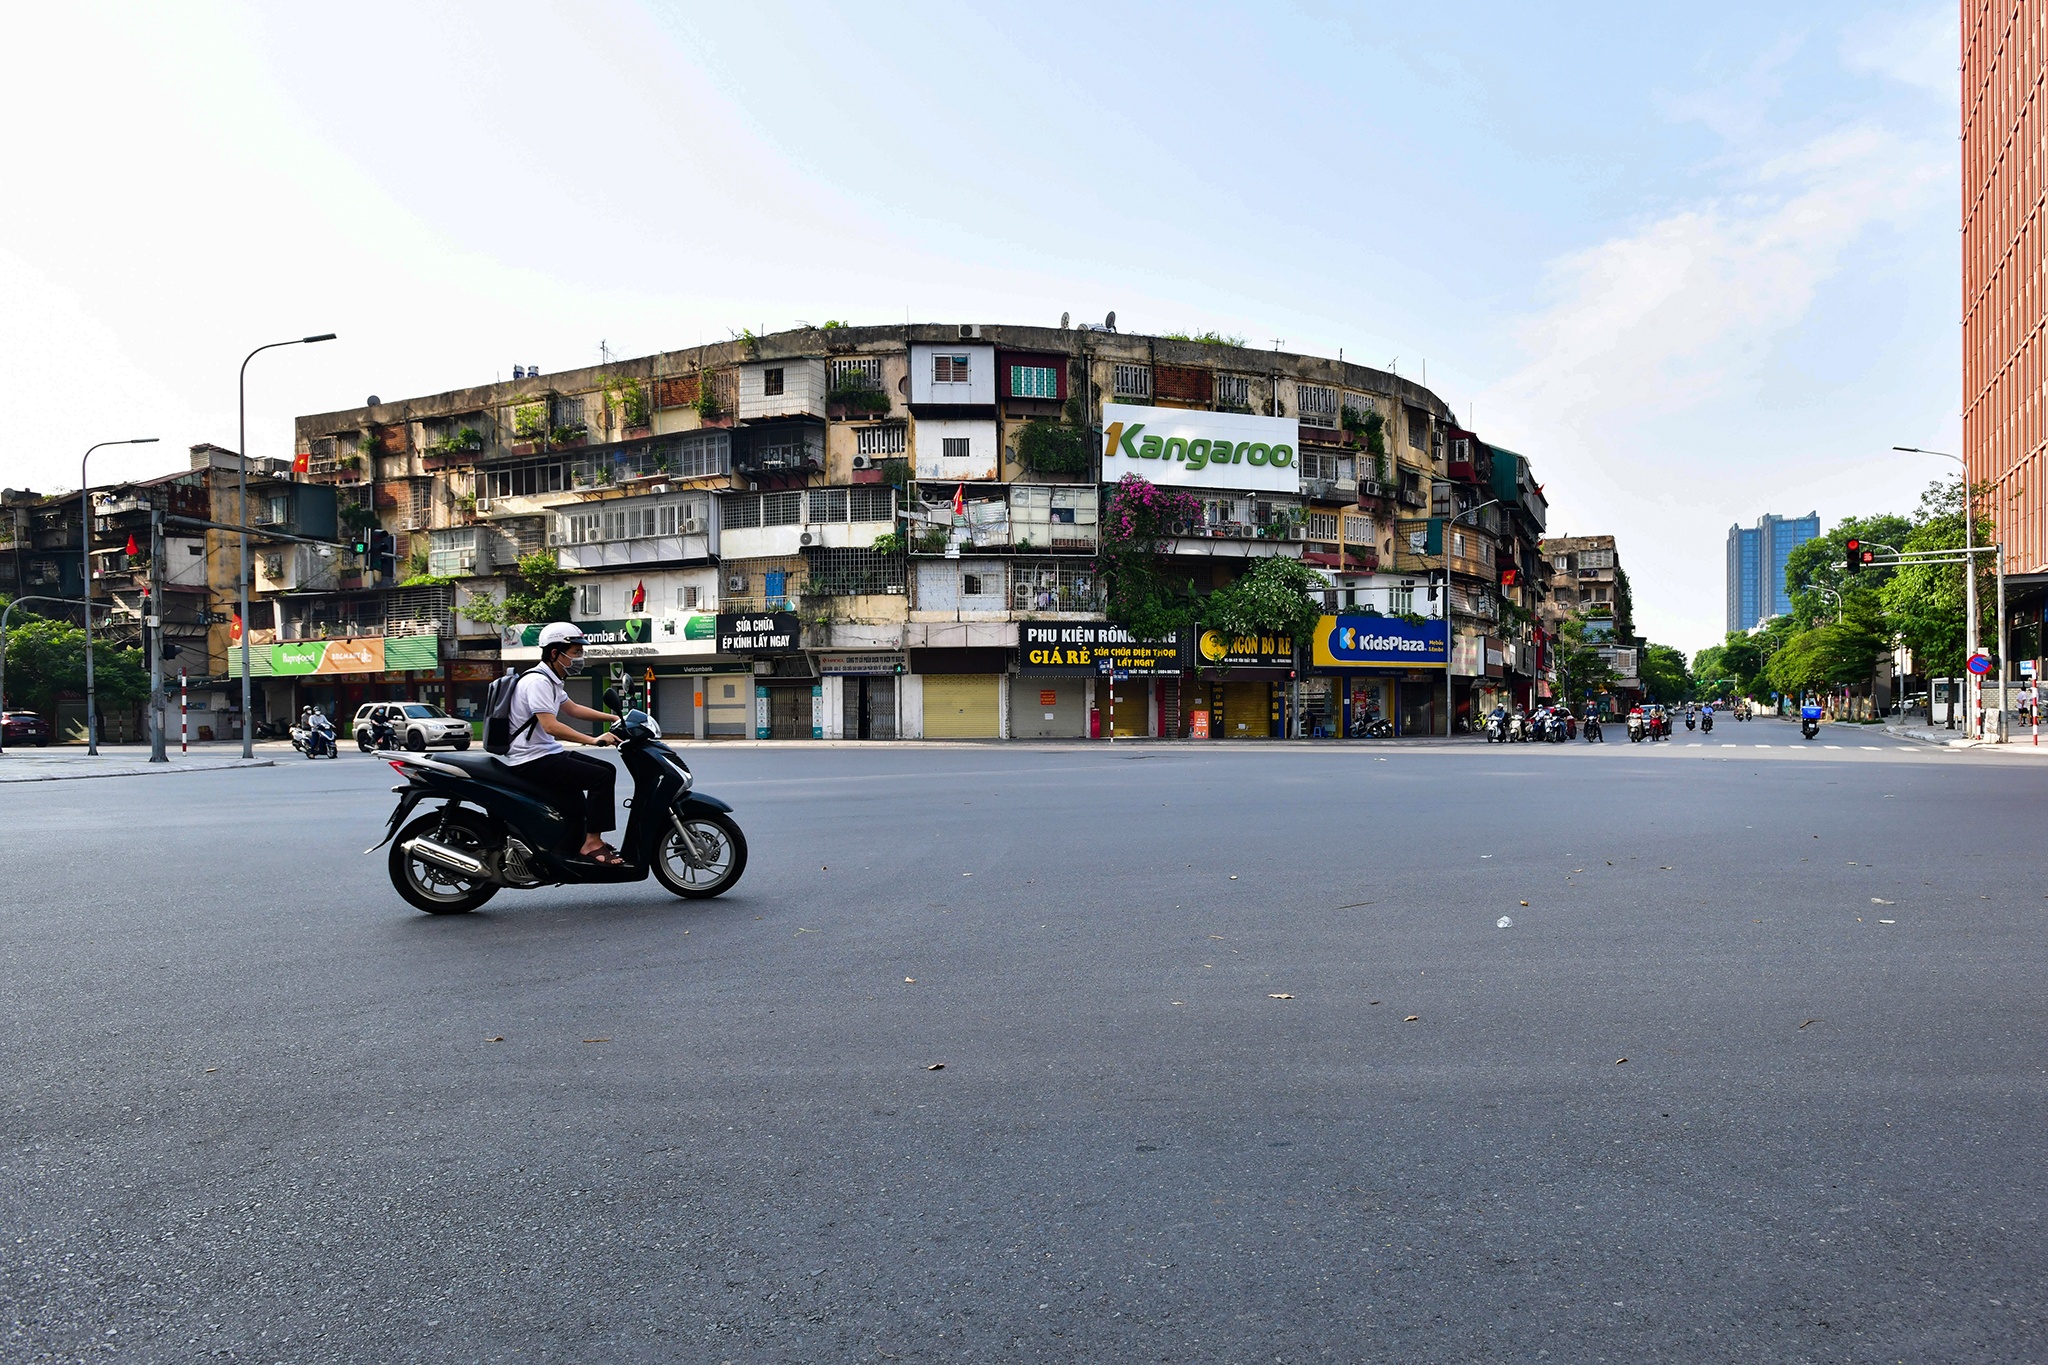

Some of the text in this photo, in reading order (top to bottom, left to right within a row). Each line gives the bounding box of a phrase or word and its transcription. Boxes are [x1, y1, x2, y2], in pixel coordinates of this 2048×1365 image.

[736, 616, 752, 632] SỬA
[753, 616, 775, 632] CHỮA
[722, 632, 790, 649] ÉP KÍNH LẤY NGAY
[1061, 626, 1095, 646] KIỆN
[1359, 634, 1427, 652] KidsPlaza
[1029, 646, 1063, 664] GIÁ
[1066, 646, 1091, 665] RẺ
[1093, 646, 1177, 658] SỬA CHỮA ĐIỆN THOẠI
[1117, 657, 1133, 667] LẤY
[1133, 658, 1155, 667] NGAY
